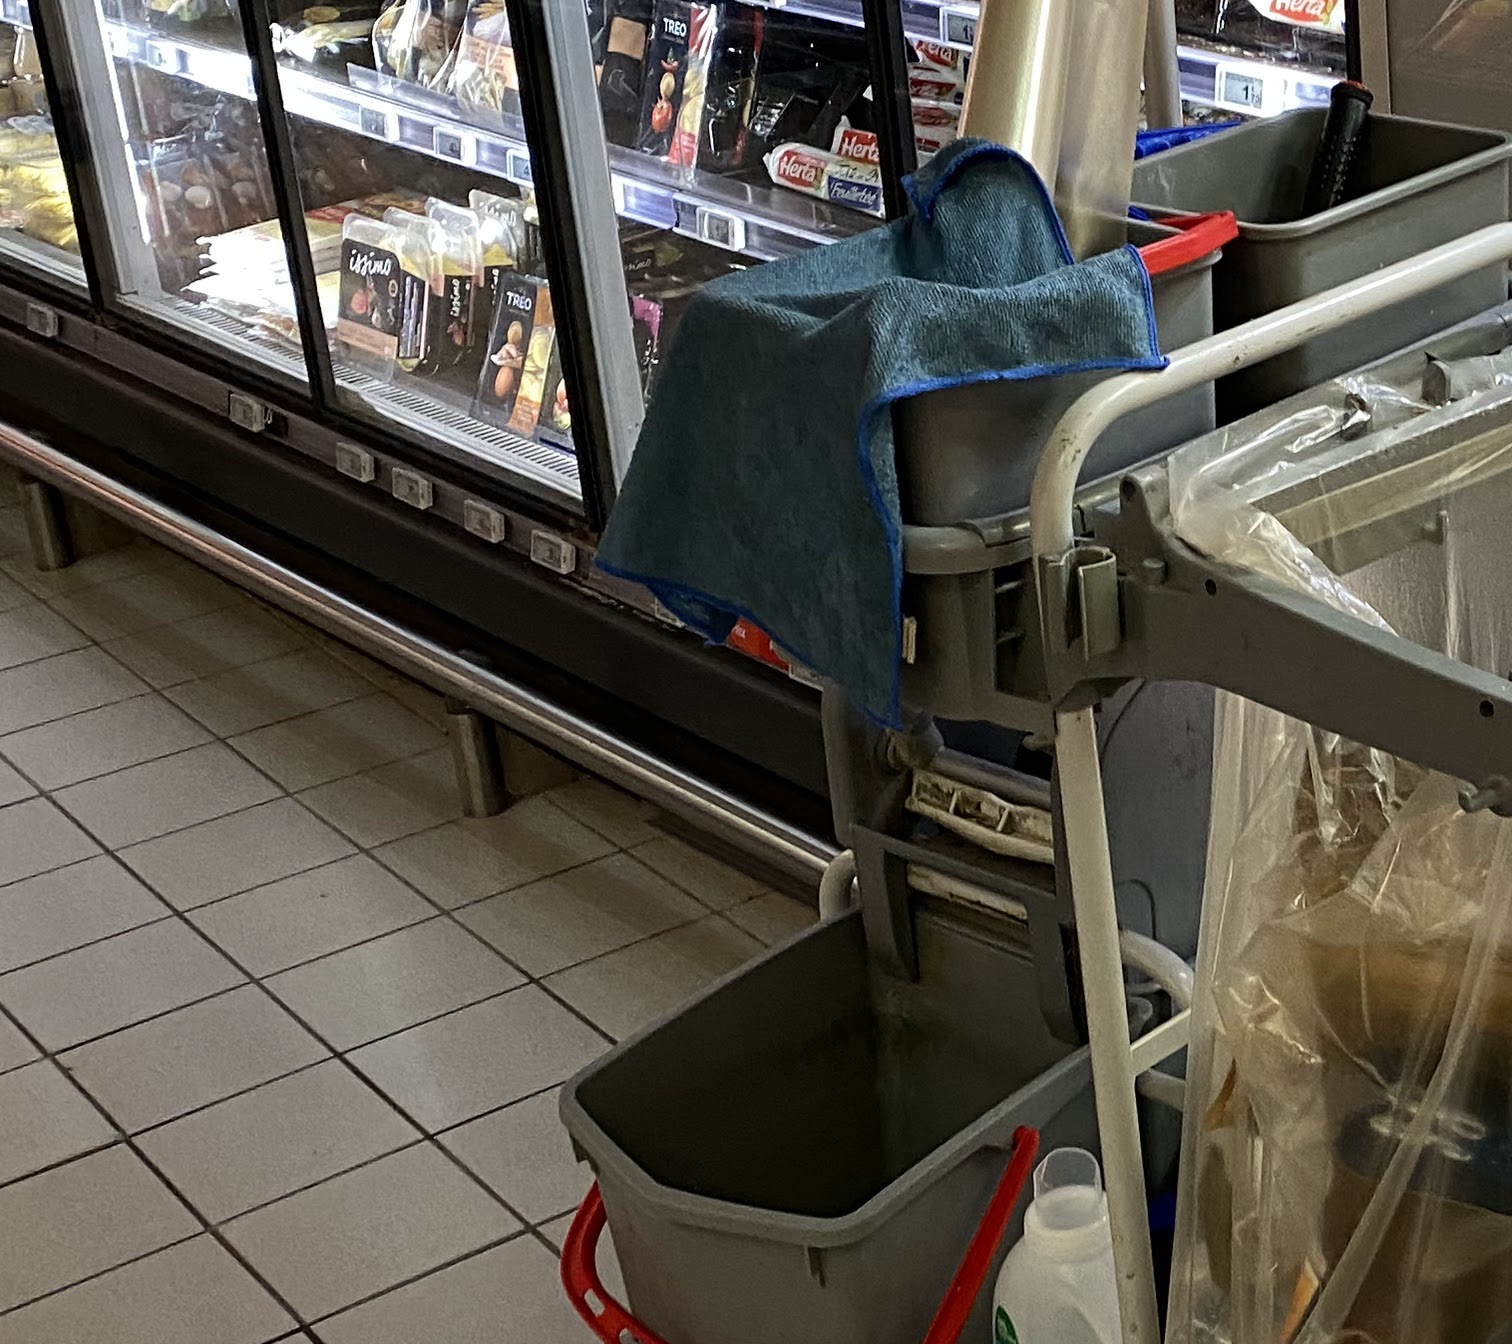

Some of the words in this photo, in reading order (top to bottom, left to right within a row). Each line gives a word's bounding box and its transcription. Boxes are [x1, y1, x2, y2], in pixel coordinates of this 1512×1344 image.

[662, 16, 688, 37] TREO
[779, 155, 816, 184] Herta
[349, 249, 392, 276] issimo
[506, 290, 533, 311] TREO
